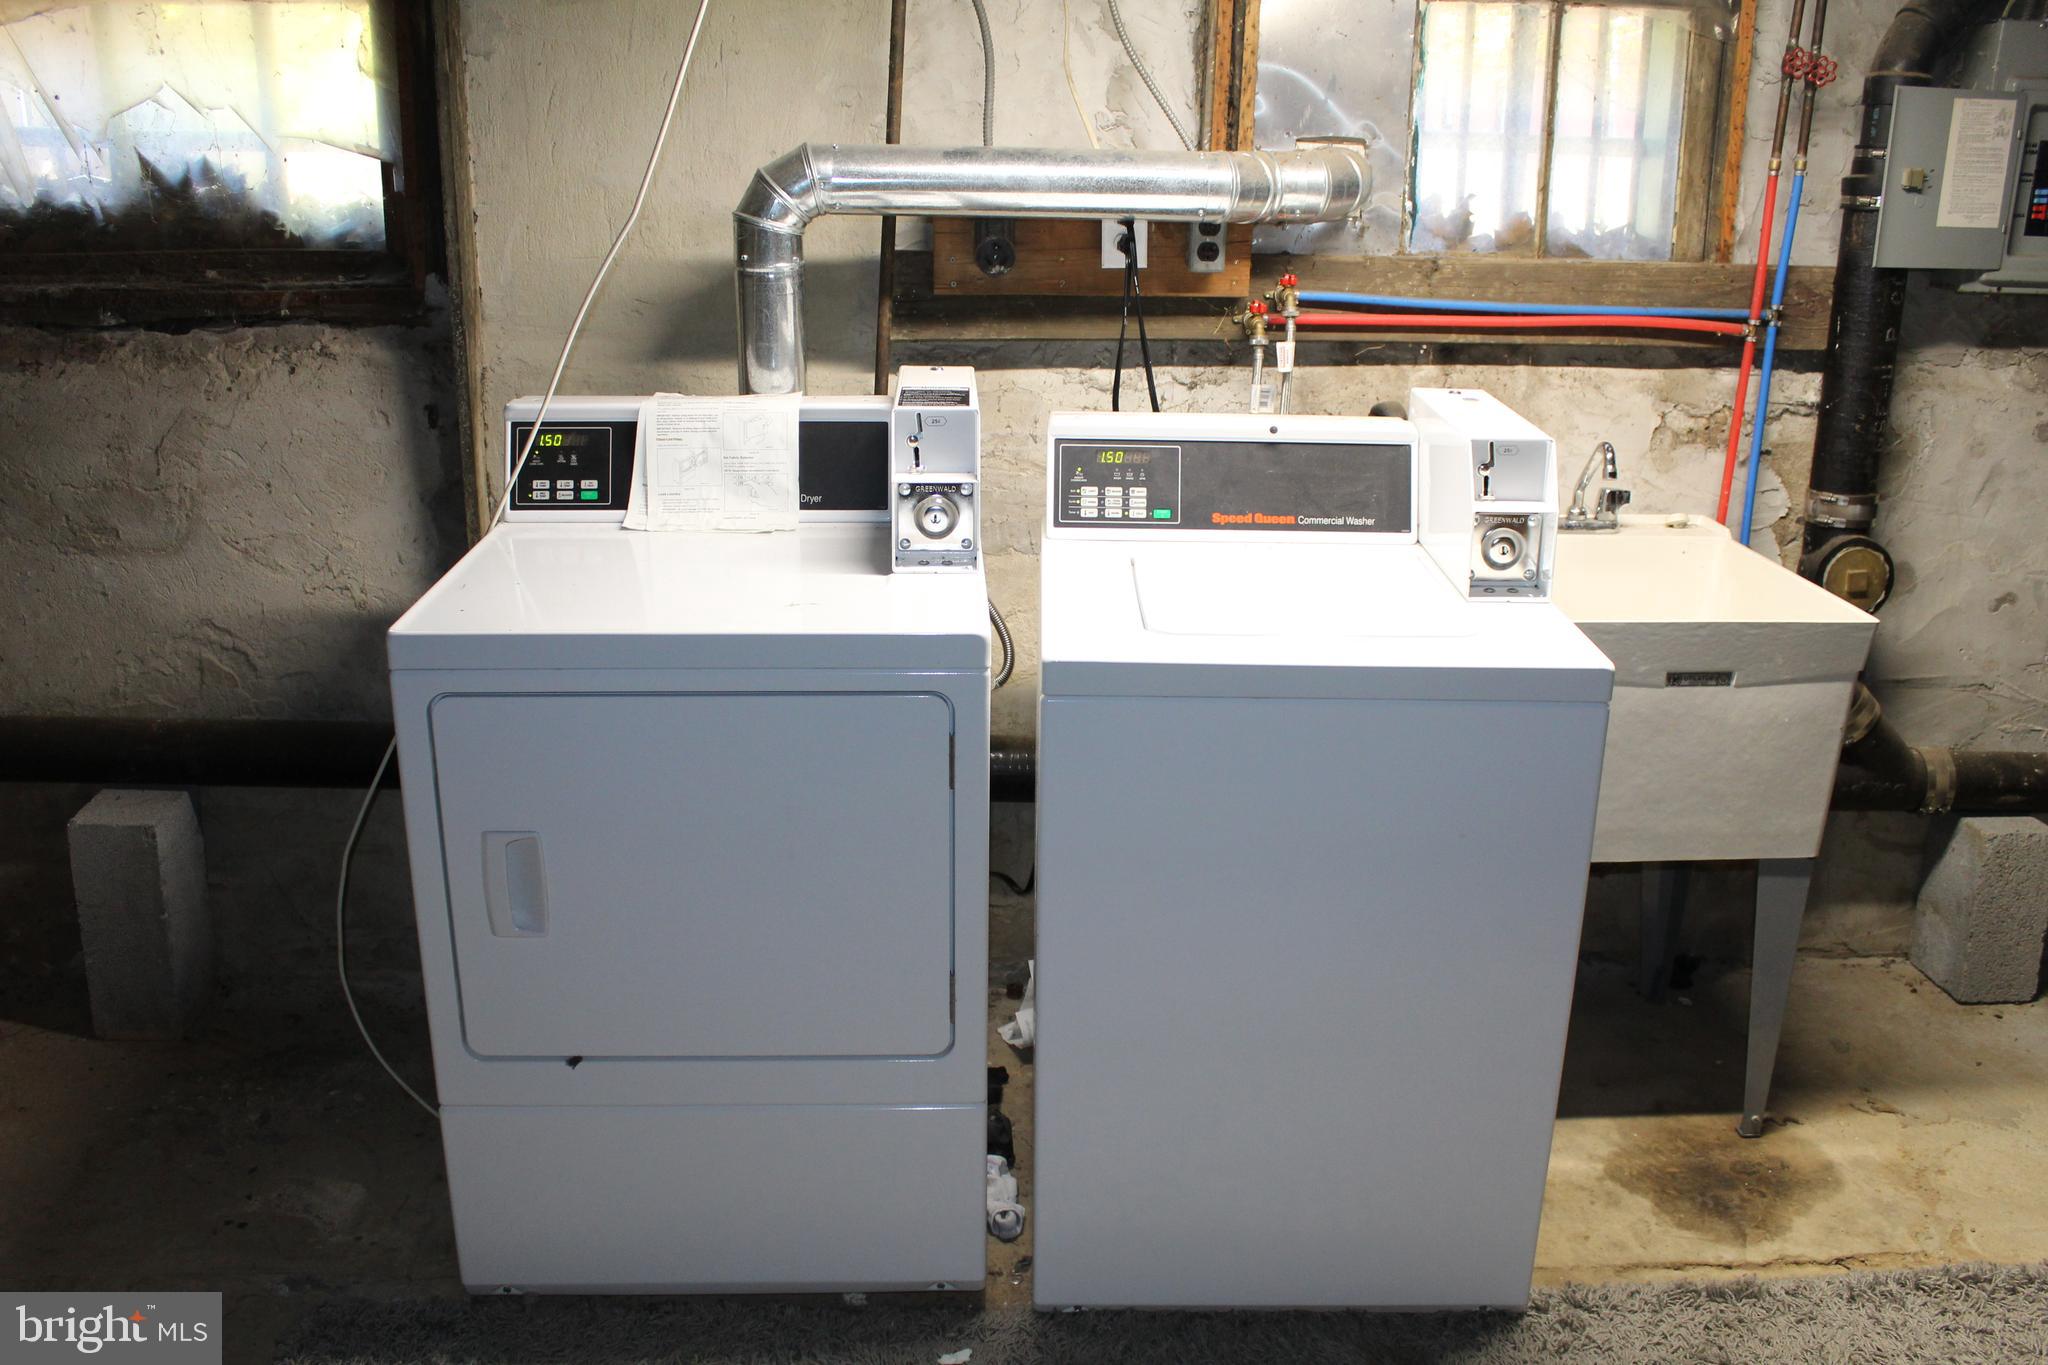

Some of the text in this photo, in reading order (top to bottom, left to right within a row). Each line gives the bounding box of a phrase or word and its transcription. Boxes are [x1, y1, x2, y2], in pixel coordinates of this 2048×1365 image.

[915, 485, 957, 493] GREENWALD
[800, 494, 822, 504] Dryer
[1211, 512, 1376, 526] Speed Queen Commercial Washer
